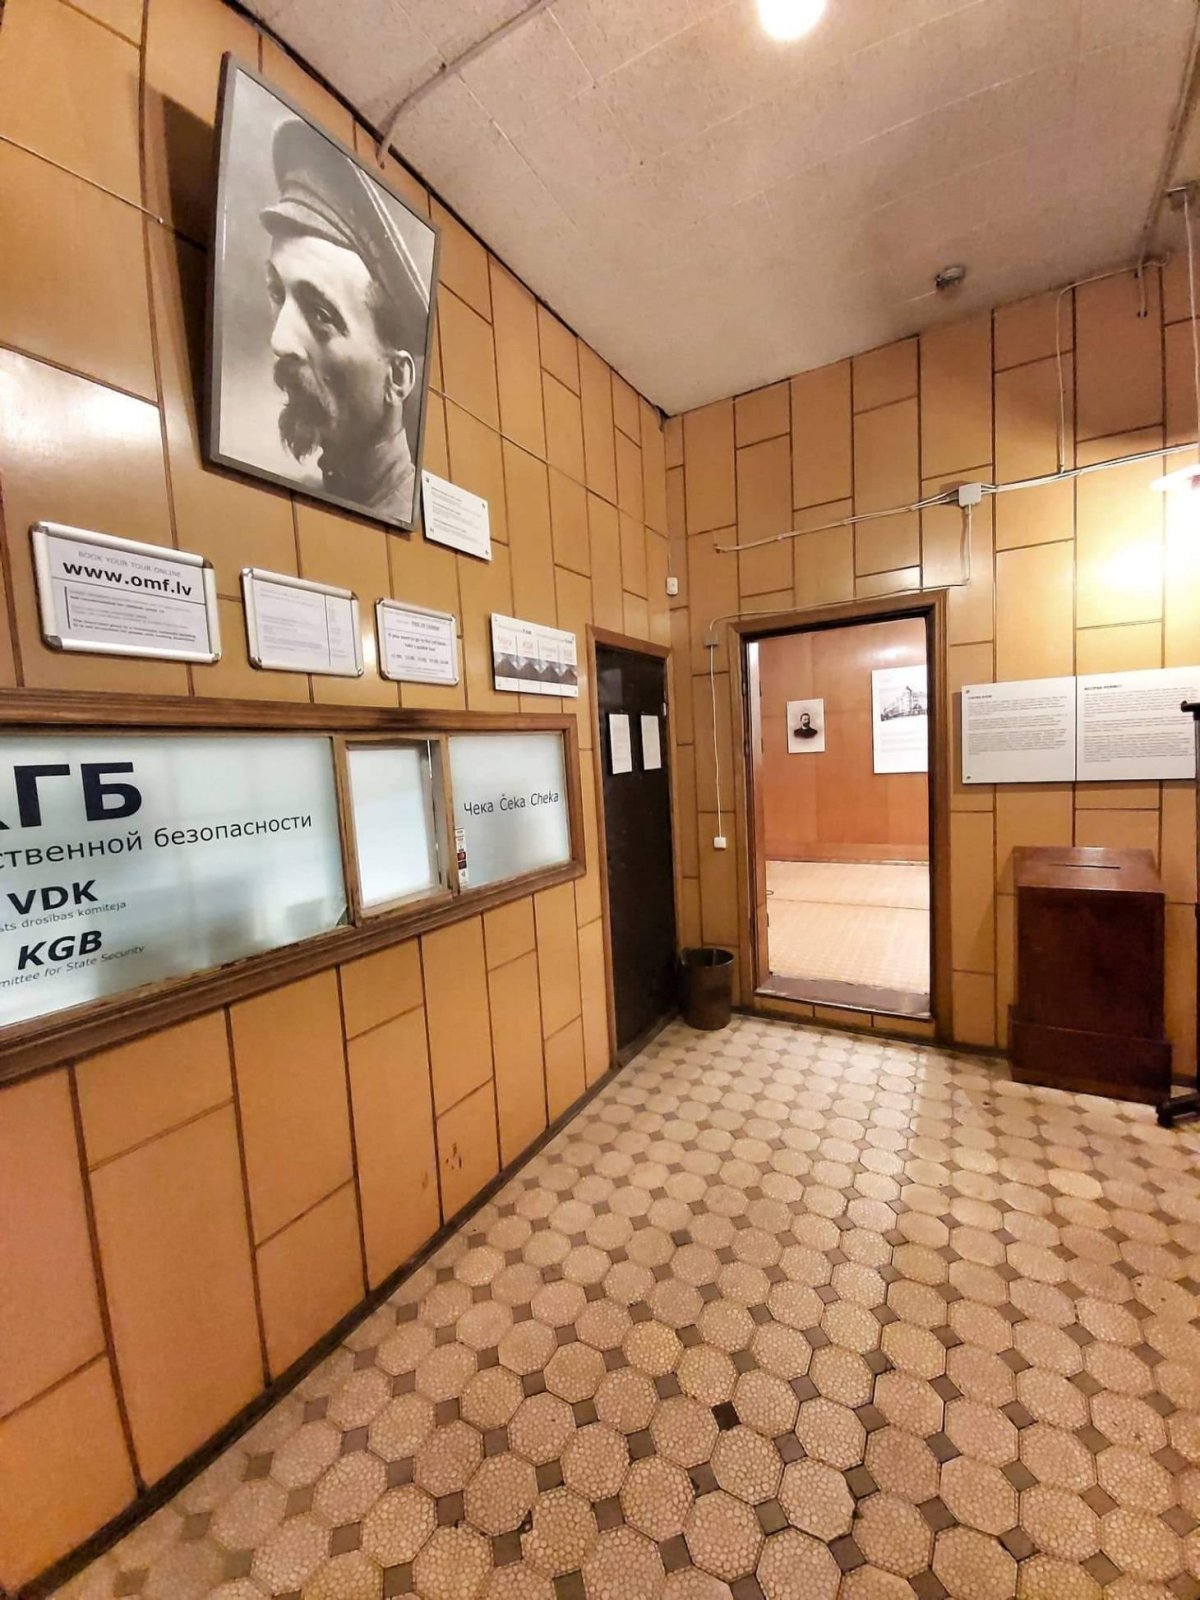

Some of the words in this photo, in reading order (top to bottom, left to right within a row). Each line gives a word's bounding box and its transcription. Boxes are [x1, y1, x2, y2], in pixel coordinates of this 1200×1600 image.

[63, 562, 192, 596] www.omf.lv
[78, 551, 102, 561] BOOK
[106, 557, 129, 567] YOUR
[131, 562, 152, 571] TOUR
[153, 566, 181, 577] ONLINE
[0, 762, 142, 830] ГБ
[463, 801, 494, 816] Чека
[531, 791, 559, 806] Cheka
[154, 815, 312, 848] безопасности
[7, 880, 98, 915] VDK
[78, 901, 126, 917] komiteja
[18, 930, 103, 971] KGB
[45, 966, 62, 977] for
[66, 957, 97, 972] State
[101, 945, 145, 962] Security
